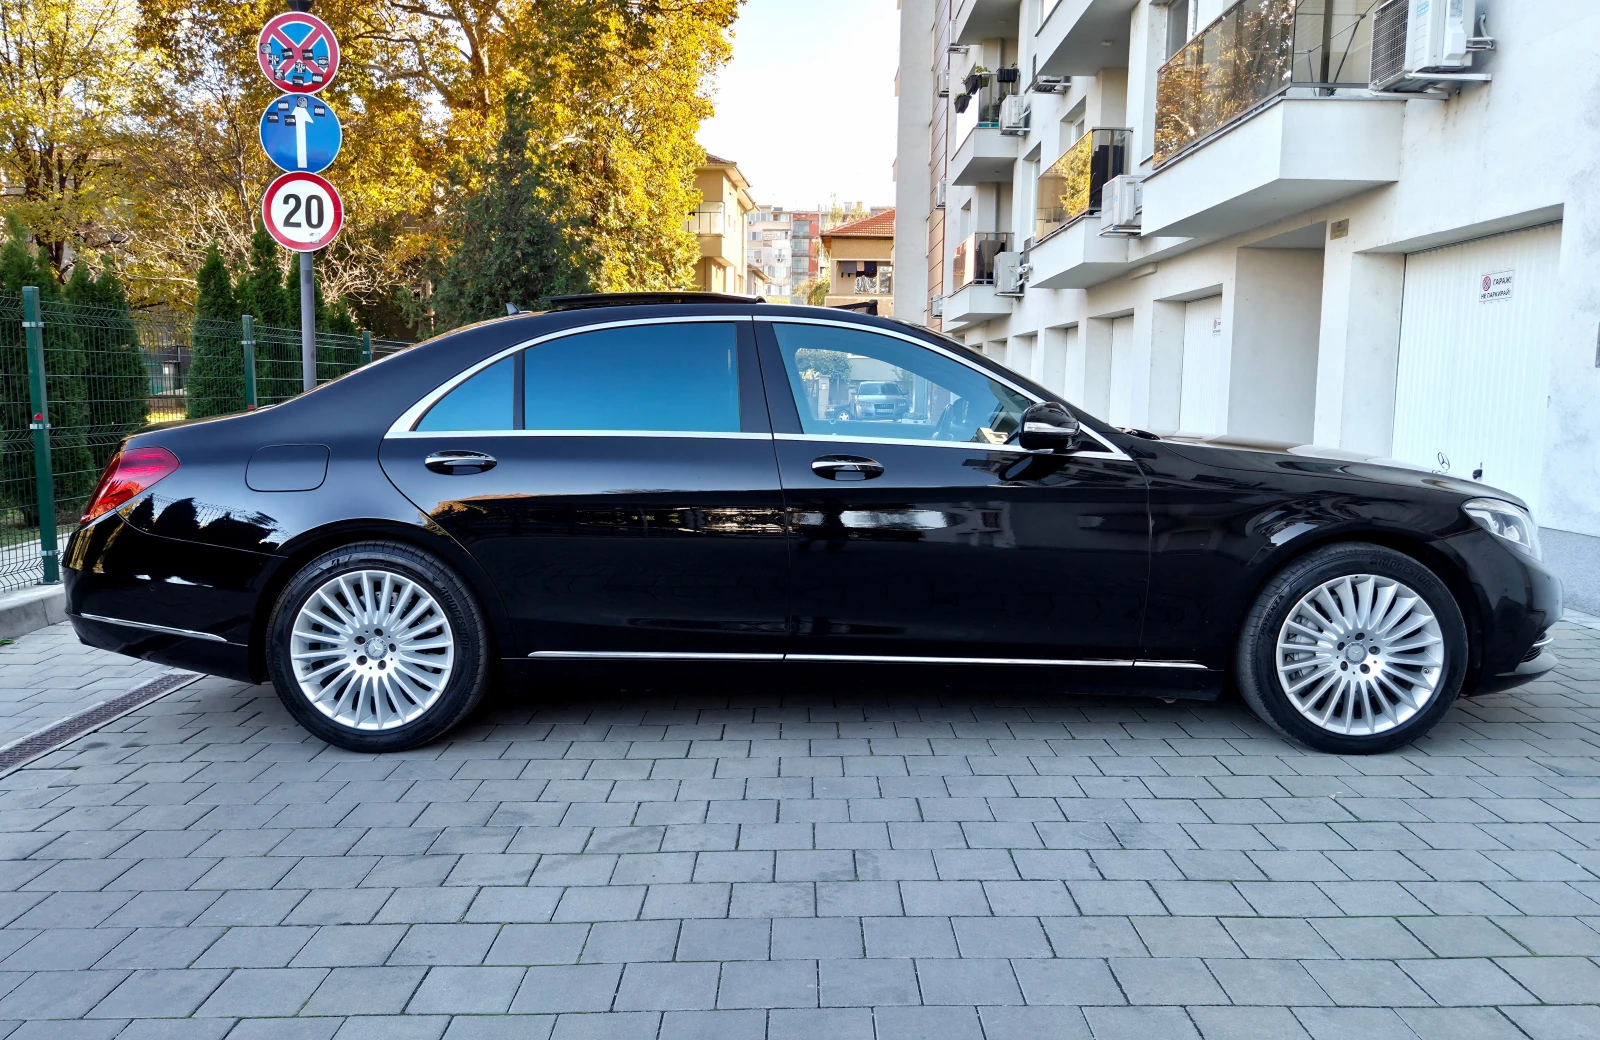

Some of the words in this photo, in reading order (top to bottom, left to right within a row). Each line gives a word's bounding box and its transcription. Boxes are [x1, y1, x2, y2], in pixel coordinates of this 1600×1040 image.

[282, 193, 325, 229] 20
[1369, 557, 1437, 589] BRIDGESTONE
[439, 586, 470, 652] BRIDGESTONE
